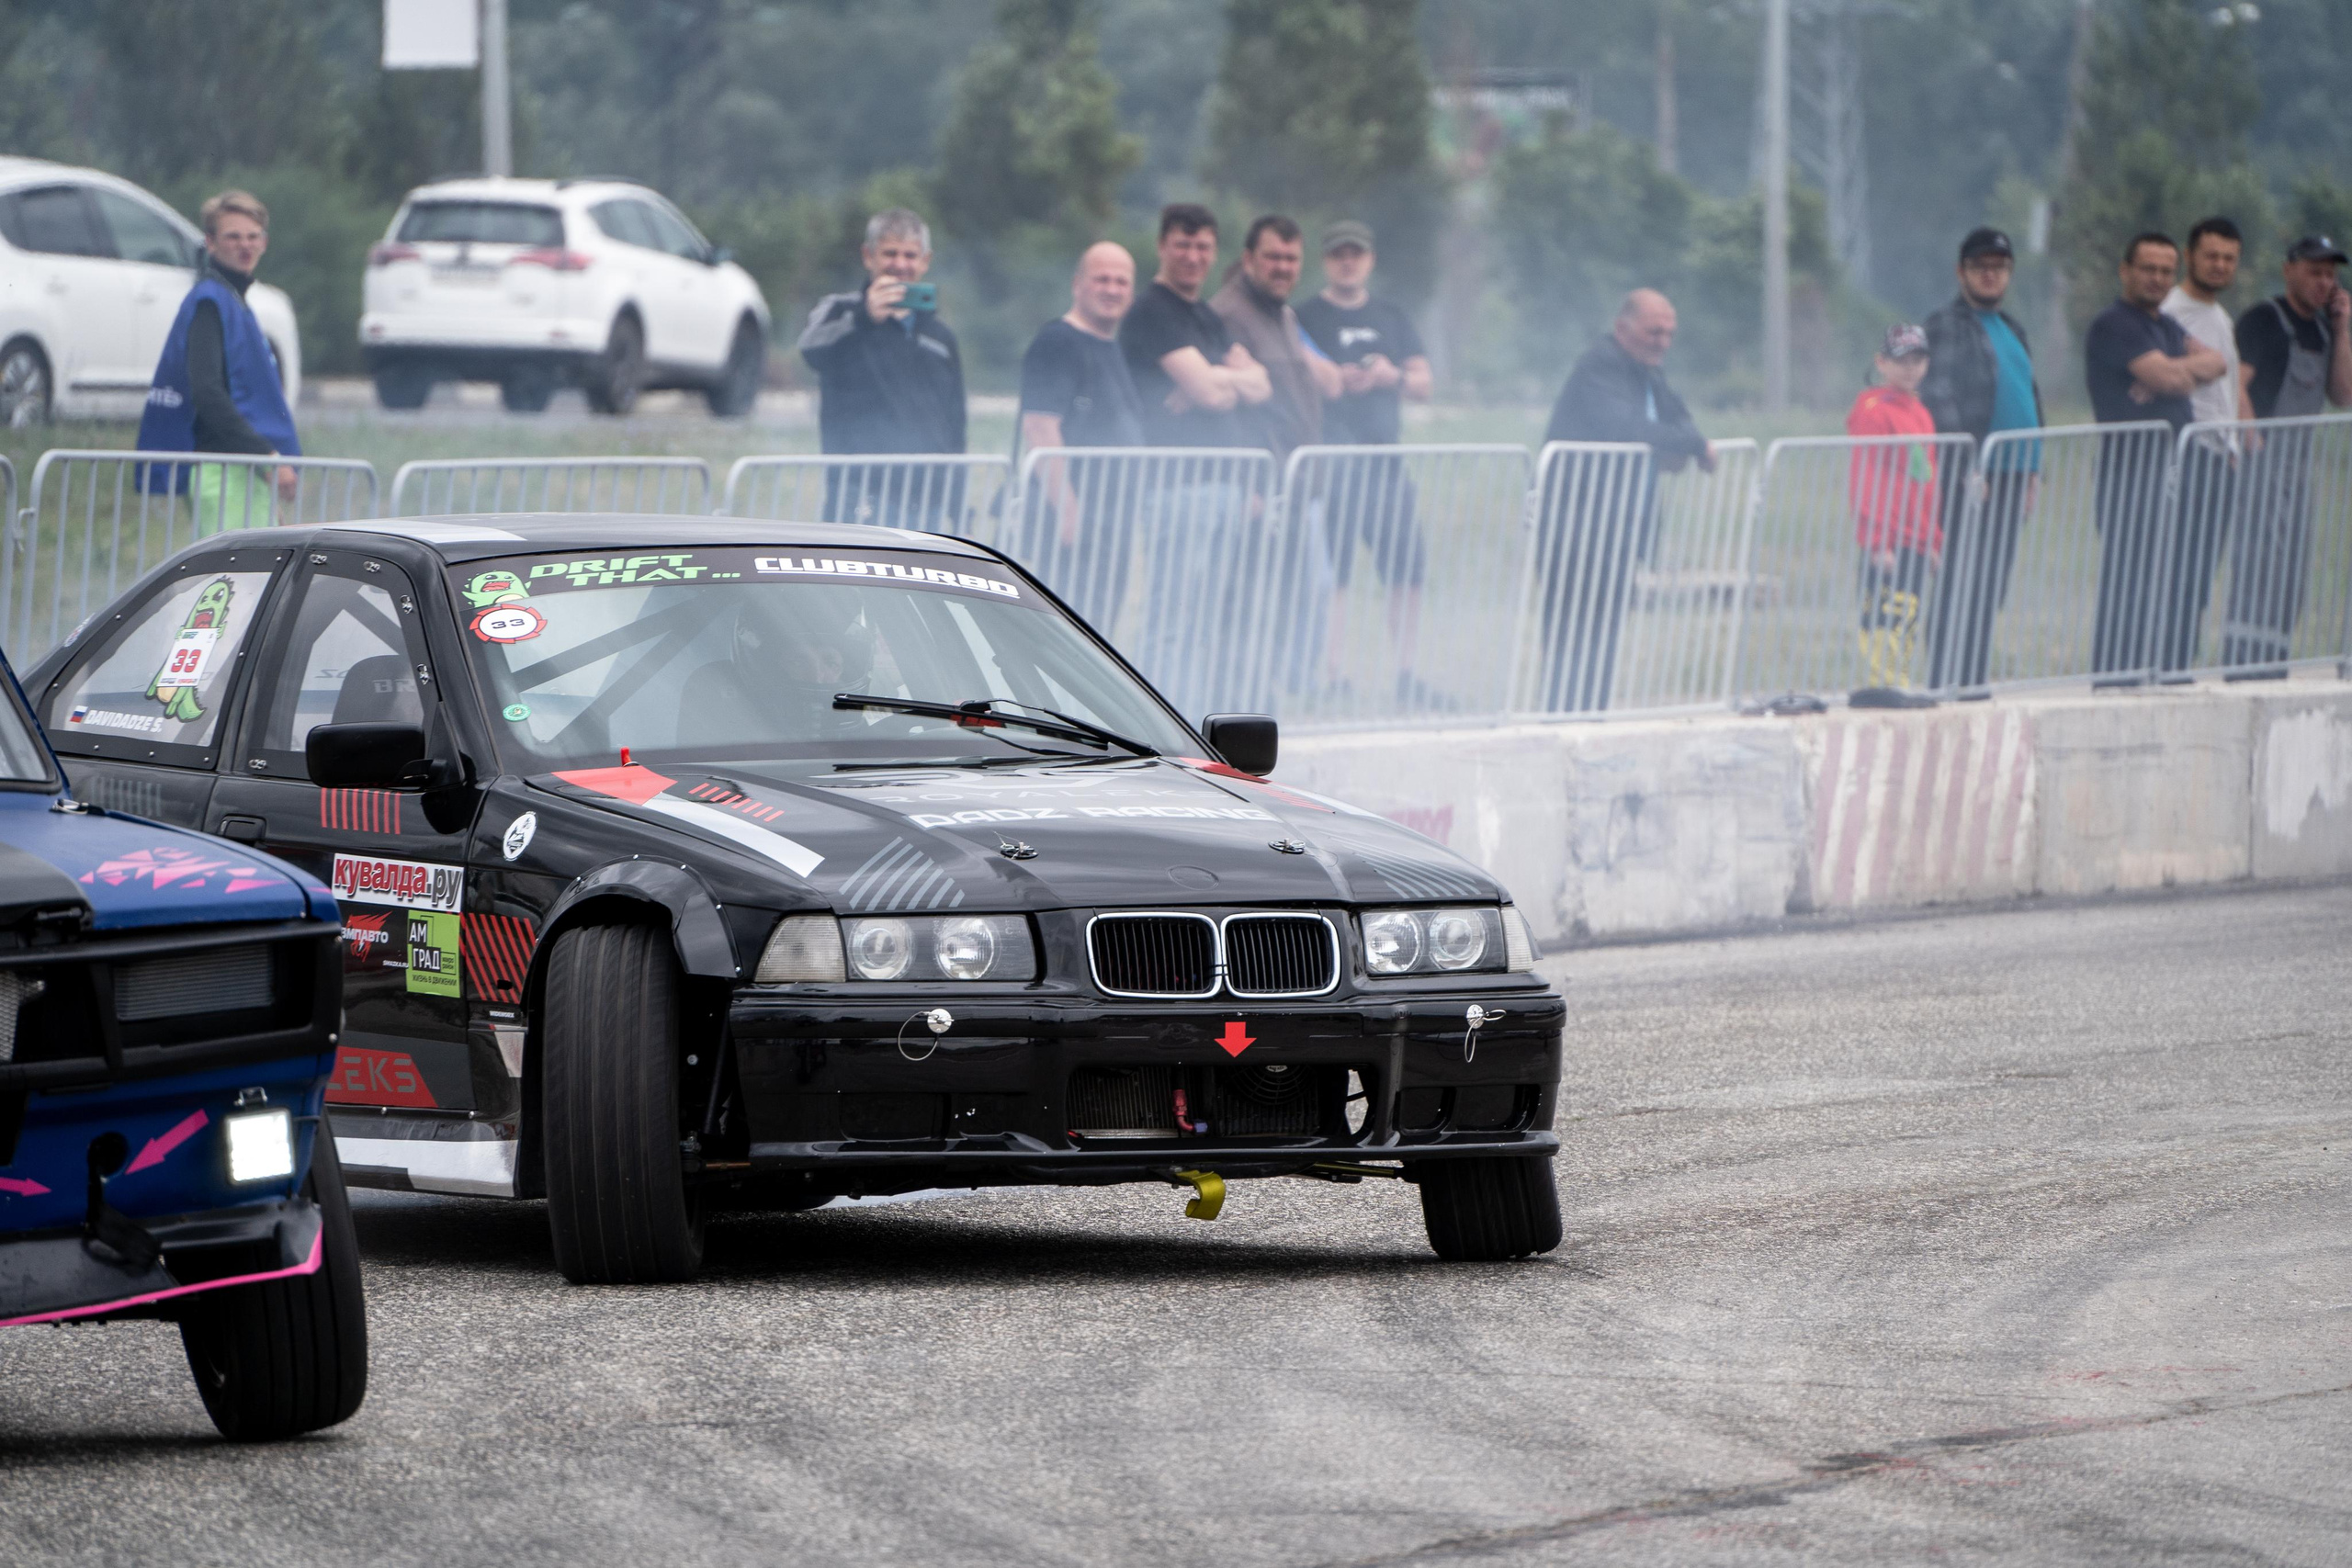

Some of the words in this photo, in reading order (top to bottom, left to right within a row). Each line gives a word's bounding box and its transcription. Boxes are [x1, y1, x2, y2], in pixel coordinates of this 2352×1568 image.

[529, 554, 693, 579] DRIFT
[753, 557, 1020, 598] CLUBTURBO
[491, 618, 526, 630] 33
[171, 649, 202, 673] 33
[84, 709, 154, 731] DAVIDADZE
[150, 716, 164, 733] S.
[905, 807, 1069, 829] DADZ
[1076, 806, 1283, 825] RACING
[334, 857, 462, 907] кувалда.ру
[409, 921, 427, 943] АМ
[413, 947, 441, 970] ГРАД
